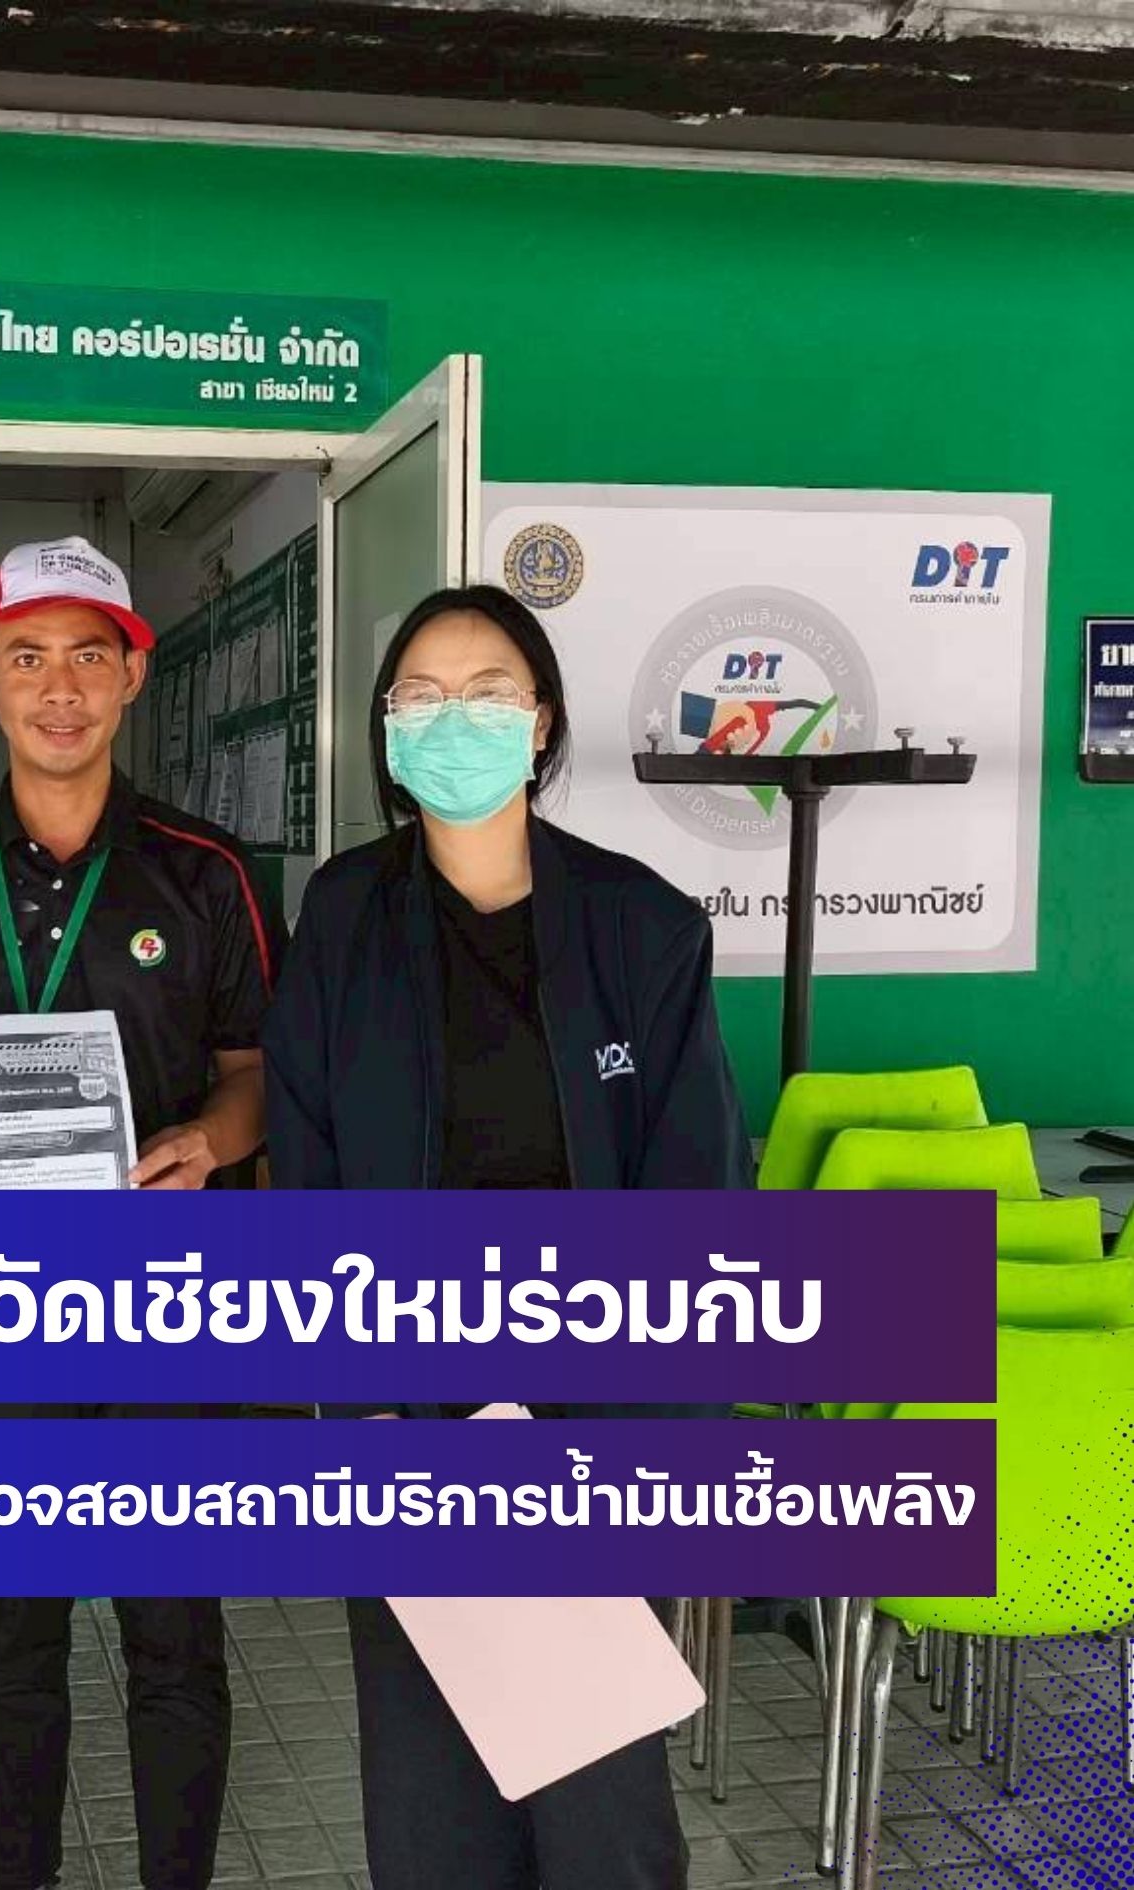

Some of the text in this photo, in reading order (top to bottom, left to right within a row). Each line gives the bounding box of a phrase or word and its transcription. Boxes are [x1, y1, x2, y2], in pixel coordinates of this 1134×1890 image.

[72, 315, 266, 364] คอร์ปอเรชั่น
[278, 325, 360, 367] จำกัด
[200, 373, 358, 402] สาขา เชียงใหม่ 2
